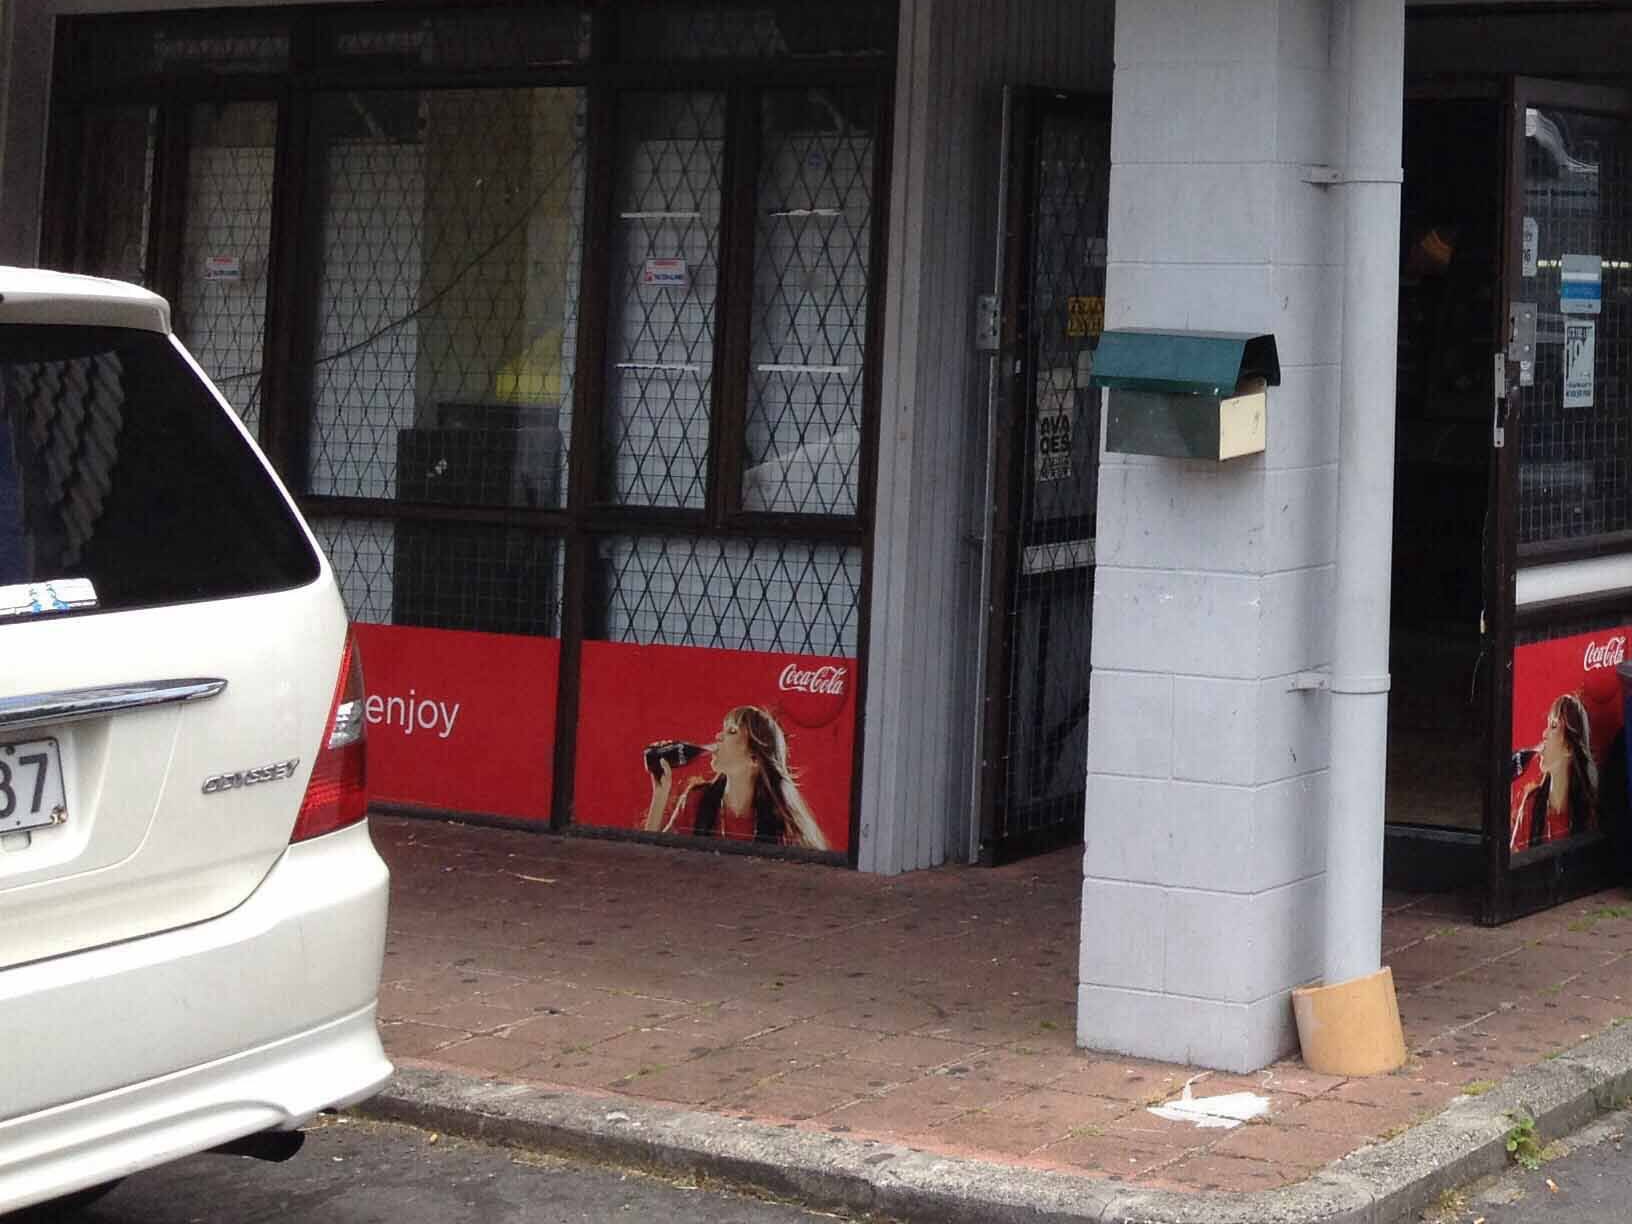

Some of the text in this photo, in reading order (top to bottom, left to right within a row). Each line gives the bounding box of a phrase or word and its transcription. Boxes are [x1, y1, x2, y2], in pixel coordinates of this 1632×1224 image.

[1583, 636, 1626, 672] Coca-Cola
[778, 663, 849, 695] Coca-Cola
[366, 687, 460, 738] enjoy
[202, 758, 301, 794] ODYSSEY
